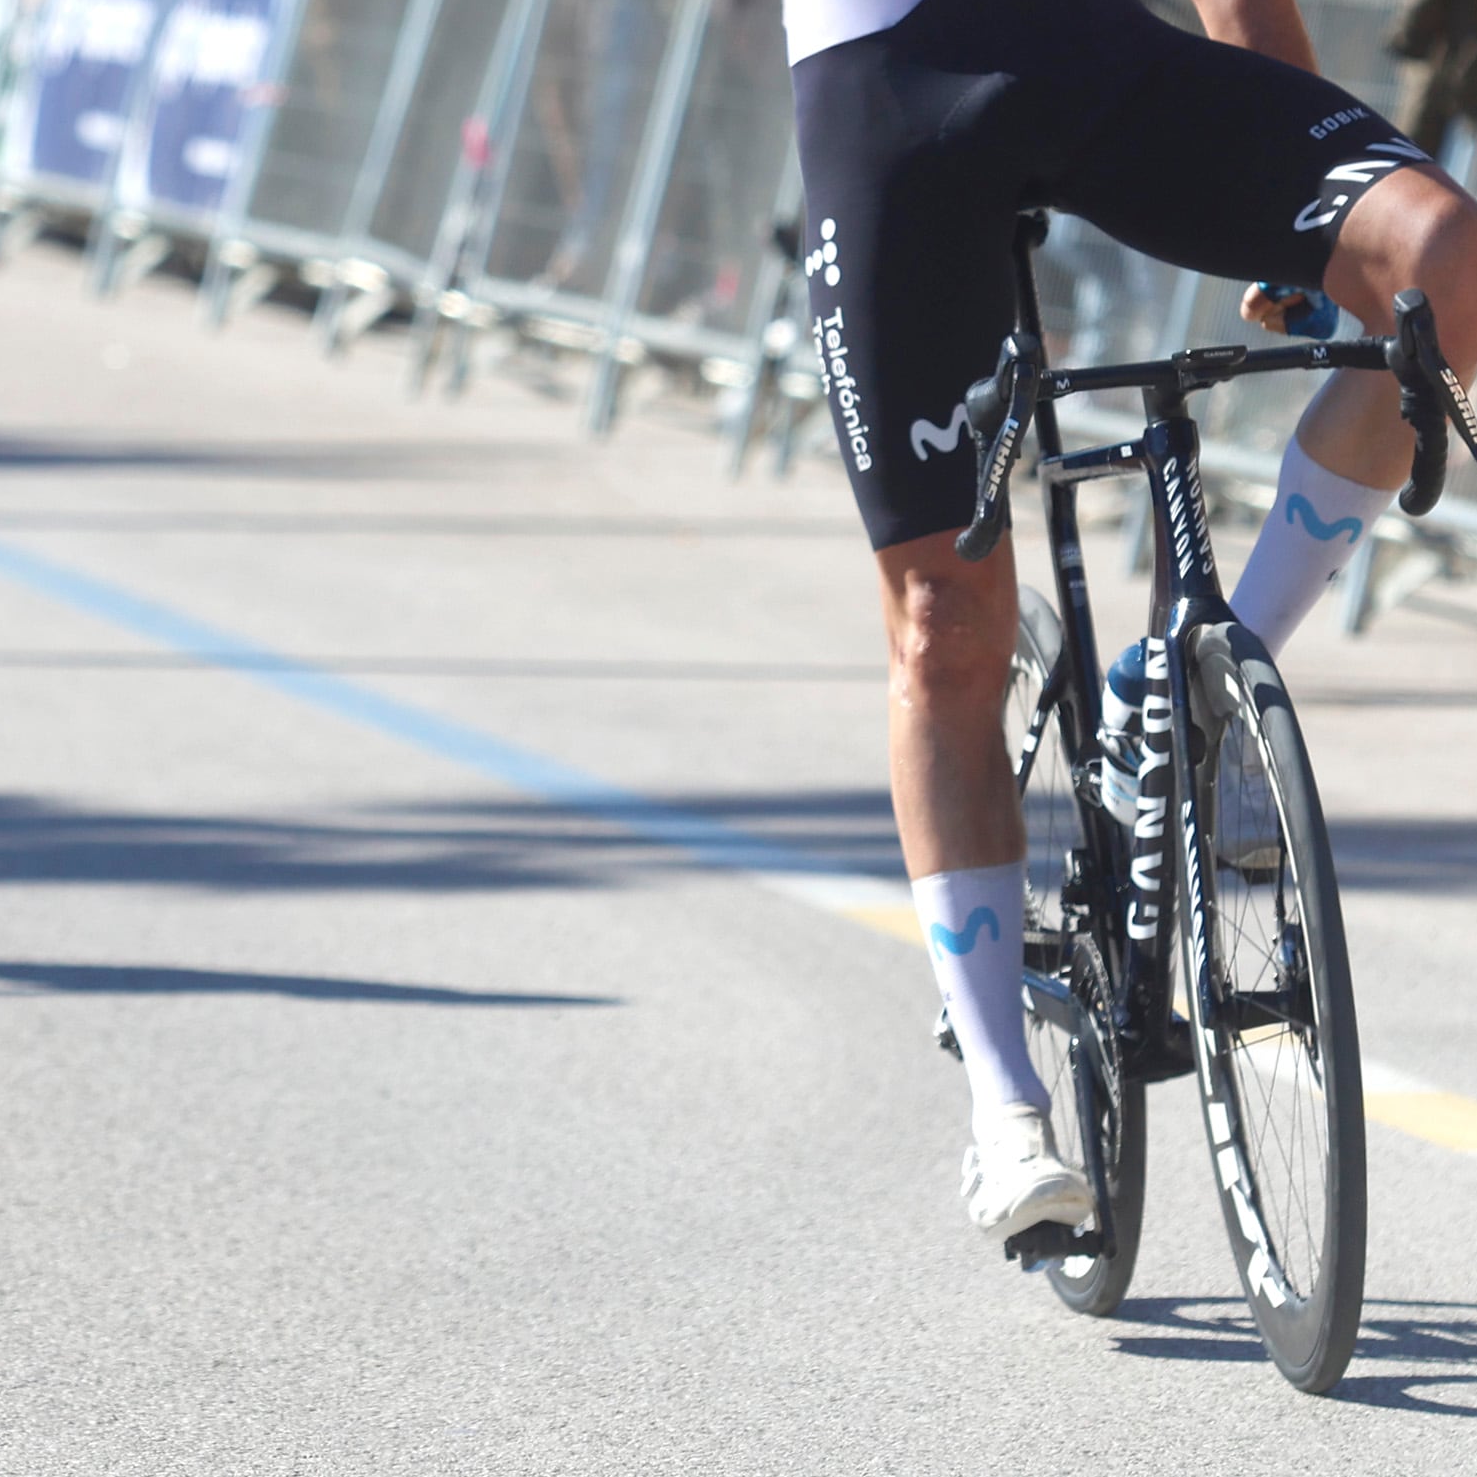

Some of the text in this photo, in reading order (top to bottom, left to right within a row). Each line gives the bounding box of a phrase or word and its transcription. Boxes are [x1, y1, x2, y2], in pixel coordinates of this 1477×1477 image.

[1308, 106, 1370, 140] GOBIK
[824, 306, 873, 473] Telefónica
[984, 417, 1020, 503] SRAM
[1162, 456, 1195, 580] CANYON
[1185, 456, 1214, 576] CANYON
[1126, 637, 1172, 940] CANYON
